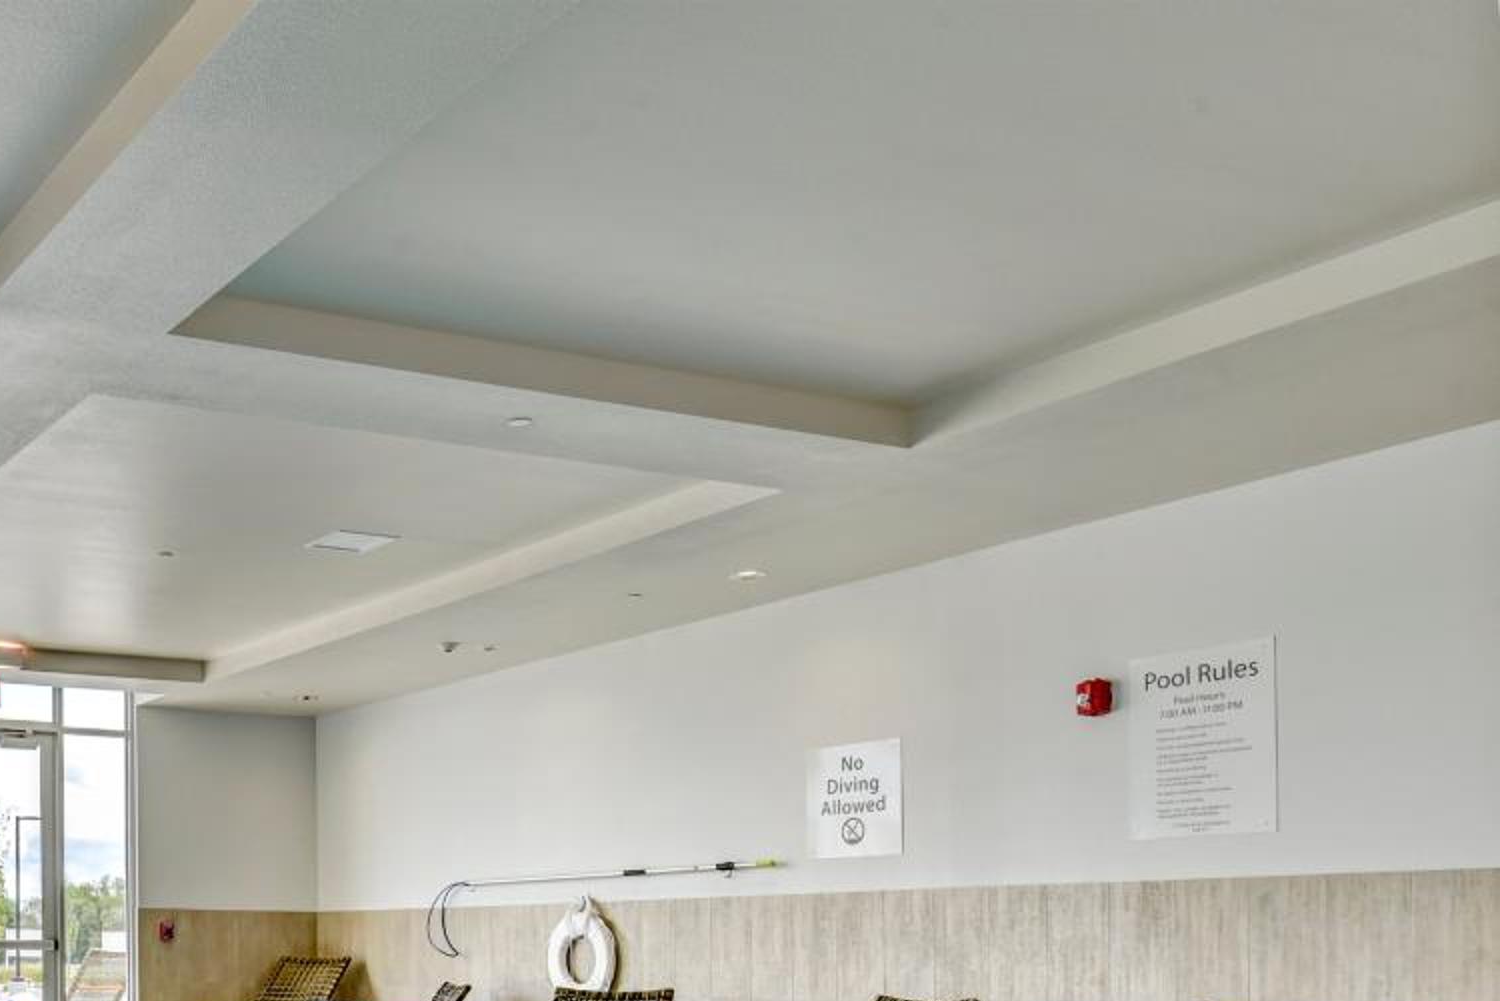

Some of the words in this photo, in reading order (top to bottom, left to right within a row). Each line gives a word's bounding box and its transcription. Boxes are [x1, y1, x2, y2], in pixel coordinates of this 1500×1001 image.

[1144, 665, 1191, 691] Pool
[1198, 659, 1260, 683] Rules
[841, 755, 864, 771] No
[827, 776, 879, 795] Diving
[821, 795, 887, 816] Allowed
